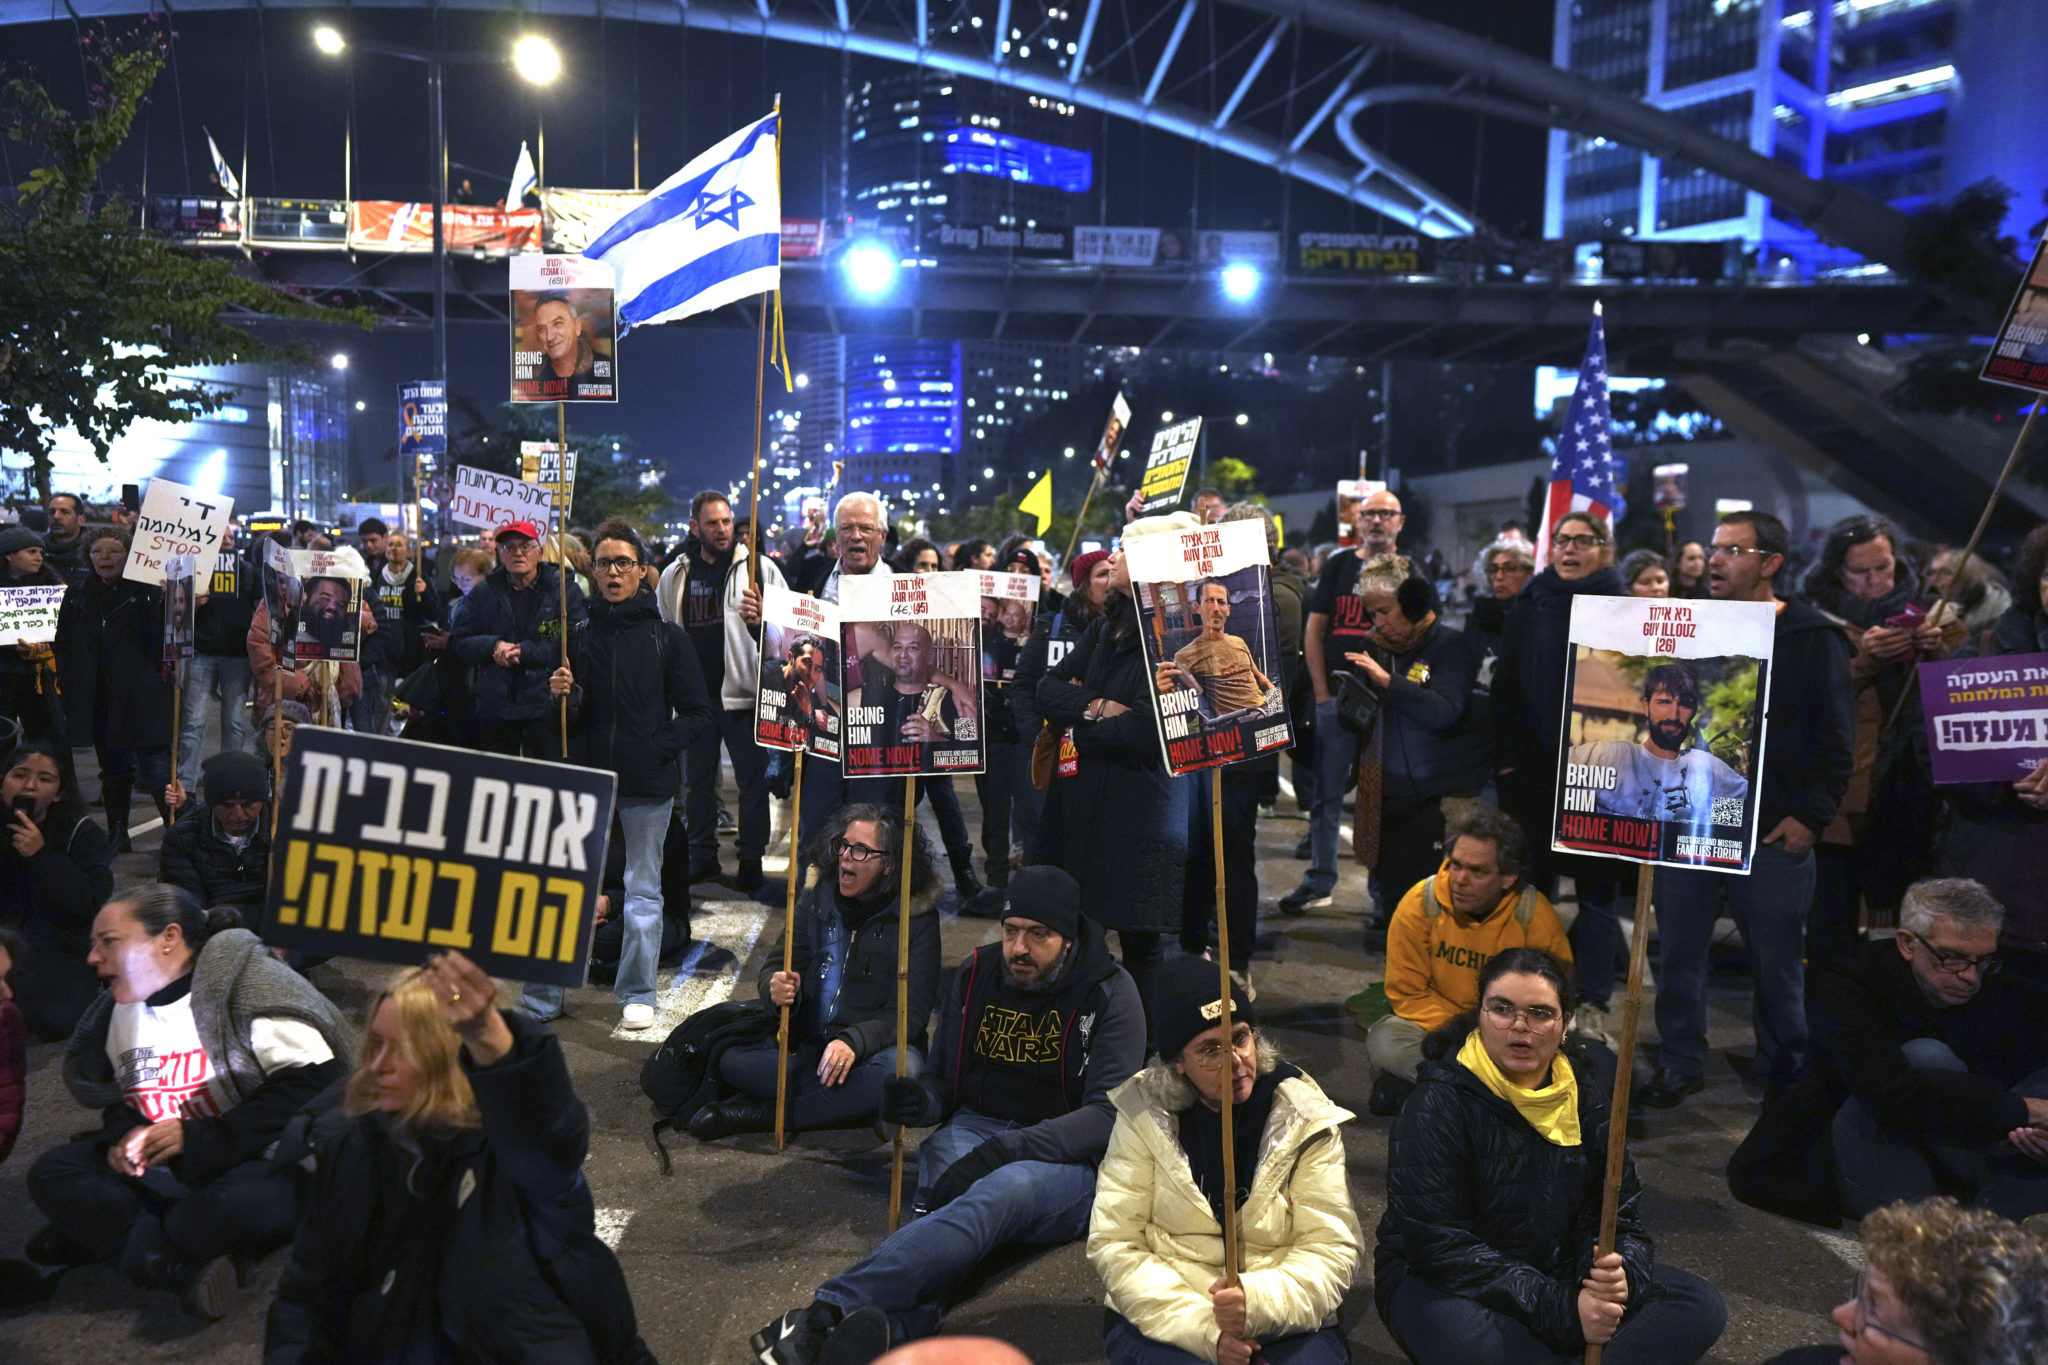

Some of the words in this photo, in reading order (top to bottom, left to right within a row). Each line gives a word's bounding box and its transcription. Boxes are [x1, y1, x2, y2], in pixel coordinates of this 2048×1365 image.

[941, 223, 978, 250] Bring
[982, 225, 1021, 247] Them
[1024, 227, 1064, 248] Home
[2004, 324, 2048, 345] BRING
[515, 351, 542, 365] BRING
[1997, 341, 2026, 359] HIM
[515, 366, 533, 379] HIM
[1989, 356, 2030, 379] HOME
[515, 381, 541, 395] HOME
[543, 378, 568, 394] NOW!
[421, 403, 442, 414] בעד
[405, 425, 444, 436] חטופים
[1151, 419, 1198, 453] הימים
[540, 452, 575, 469] המים
[539, 469, 573, 482] מרבים
[517, 482, 551, 507] אתה
[180, 497, 216, 520] די
[139, 516, 217, 545] למלחמה
[150, 535, 201, 556] STOP
[1183, 548, 1200, 562] AVIV
[134, 551, 161, 569] The
[1197, 559, 1214, 576] (49)
[891, 591, 907, 603] IAIR
[1333, 595, 1373, 627] שיו
[1674, 607, 1692, 622] גיא
[13, 621, 20, 630] 8
[1642, 622, 1661, 636] GUY
[1661, 623, 1697, 638] ILLOUZ
[1655, 637, 1676, 654] (26)
[1946, 669, 2019, 690] העסקה
[761, 688, 787, 708] BRING
[1159, 688, 1199, 717] BRING
[1949, 686, 2026, 704] המלחמה
[760, 704, 777, 721] HIM
[847, 706, 885, 725] BRING
[759, 721, 783, 739] HOME
[848, 726, 872, 745] HIM
[1163, 713, 1189, 740] HIM
[1941, 718, 2038, 744] מעזה!
[848, 747, 883, 766] HOME
[886, 743, 920, 765] NOW!
[1169, 737, 1206, 766] HOME
[1206, 725, 1243, 757] NOW!
[933, 757, 959, 766] FAMILIES
[959, 756, 979, 765] FORUM
[1060, 760, 1076, 774] HOME
[1565, 763, 1617, 790] BRING
[292, 751, 451, 850] בבית
[1563, 787, 1597, 813] HIM
[464, 776, 598, 872] אתם
[1561, 813, 1608, 842] HOME
[1612, 819, 1659, 849] NOW!
[1677, 835, 1705, 846] HOSTAGES
[1705, 837, 1717, 847] AND
[1717, 837, 1743, 849] MISSING
[1676, 843, 1712, 857] FAMILIES
[1712, 846, 1743, 861] FORUM
[278, 839, 478, 949] בעזה!
[491, 870, 585, 963] הם
